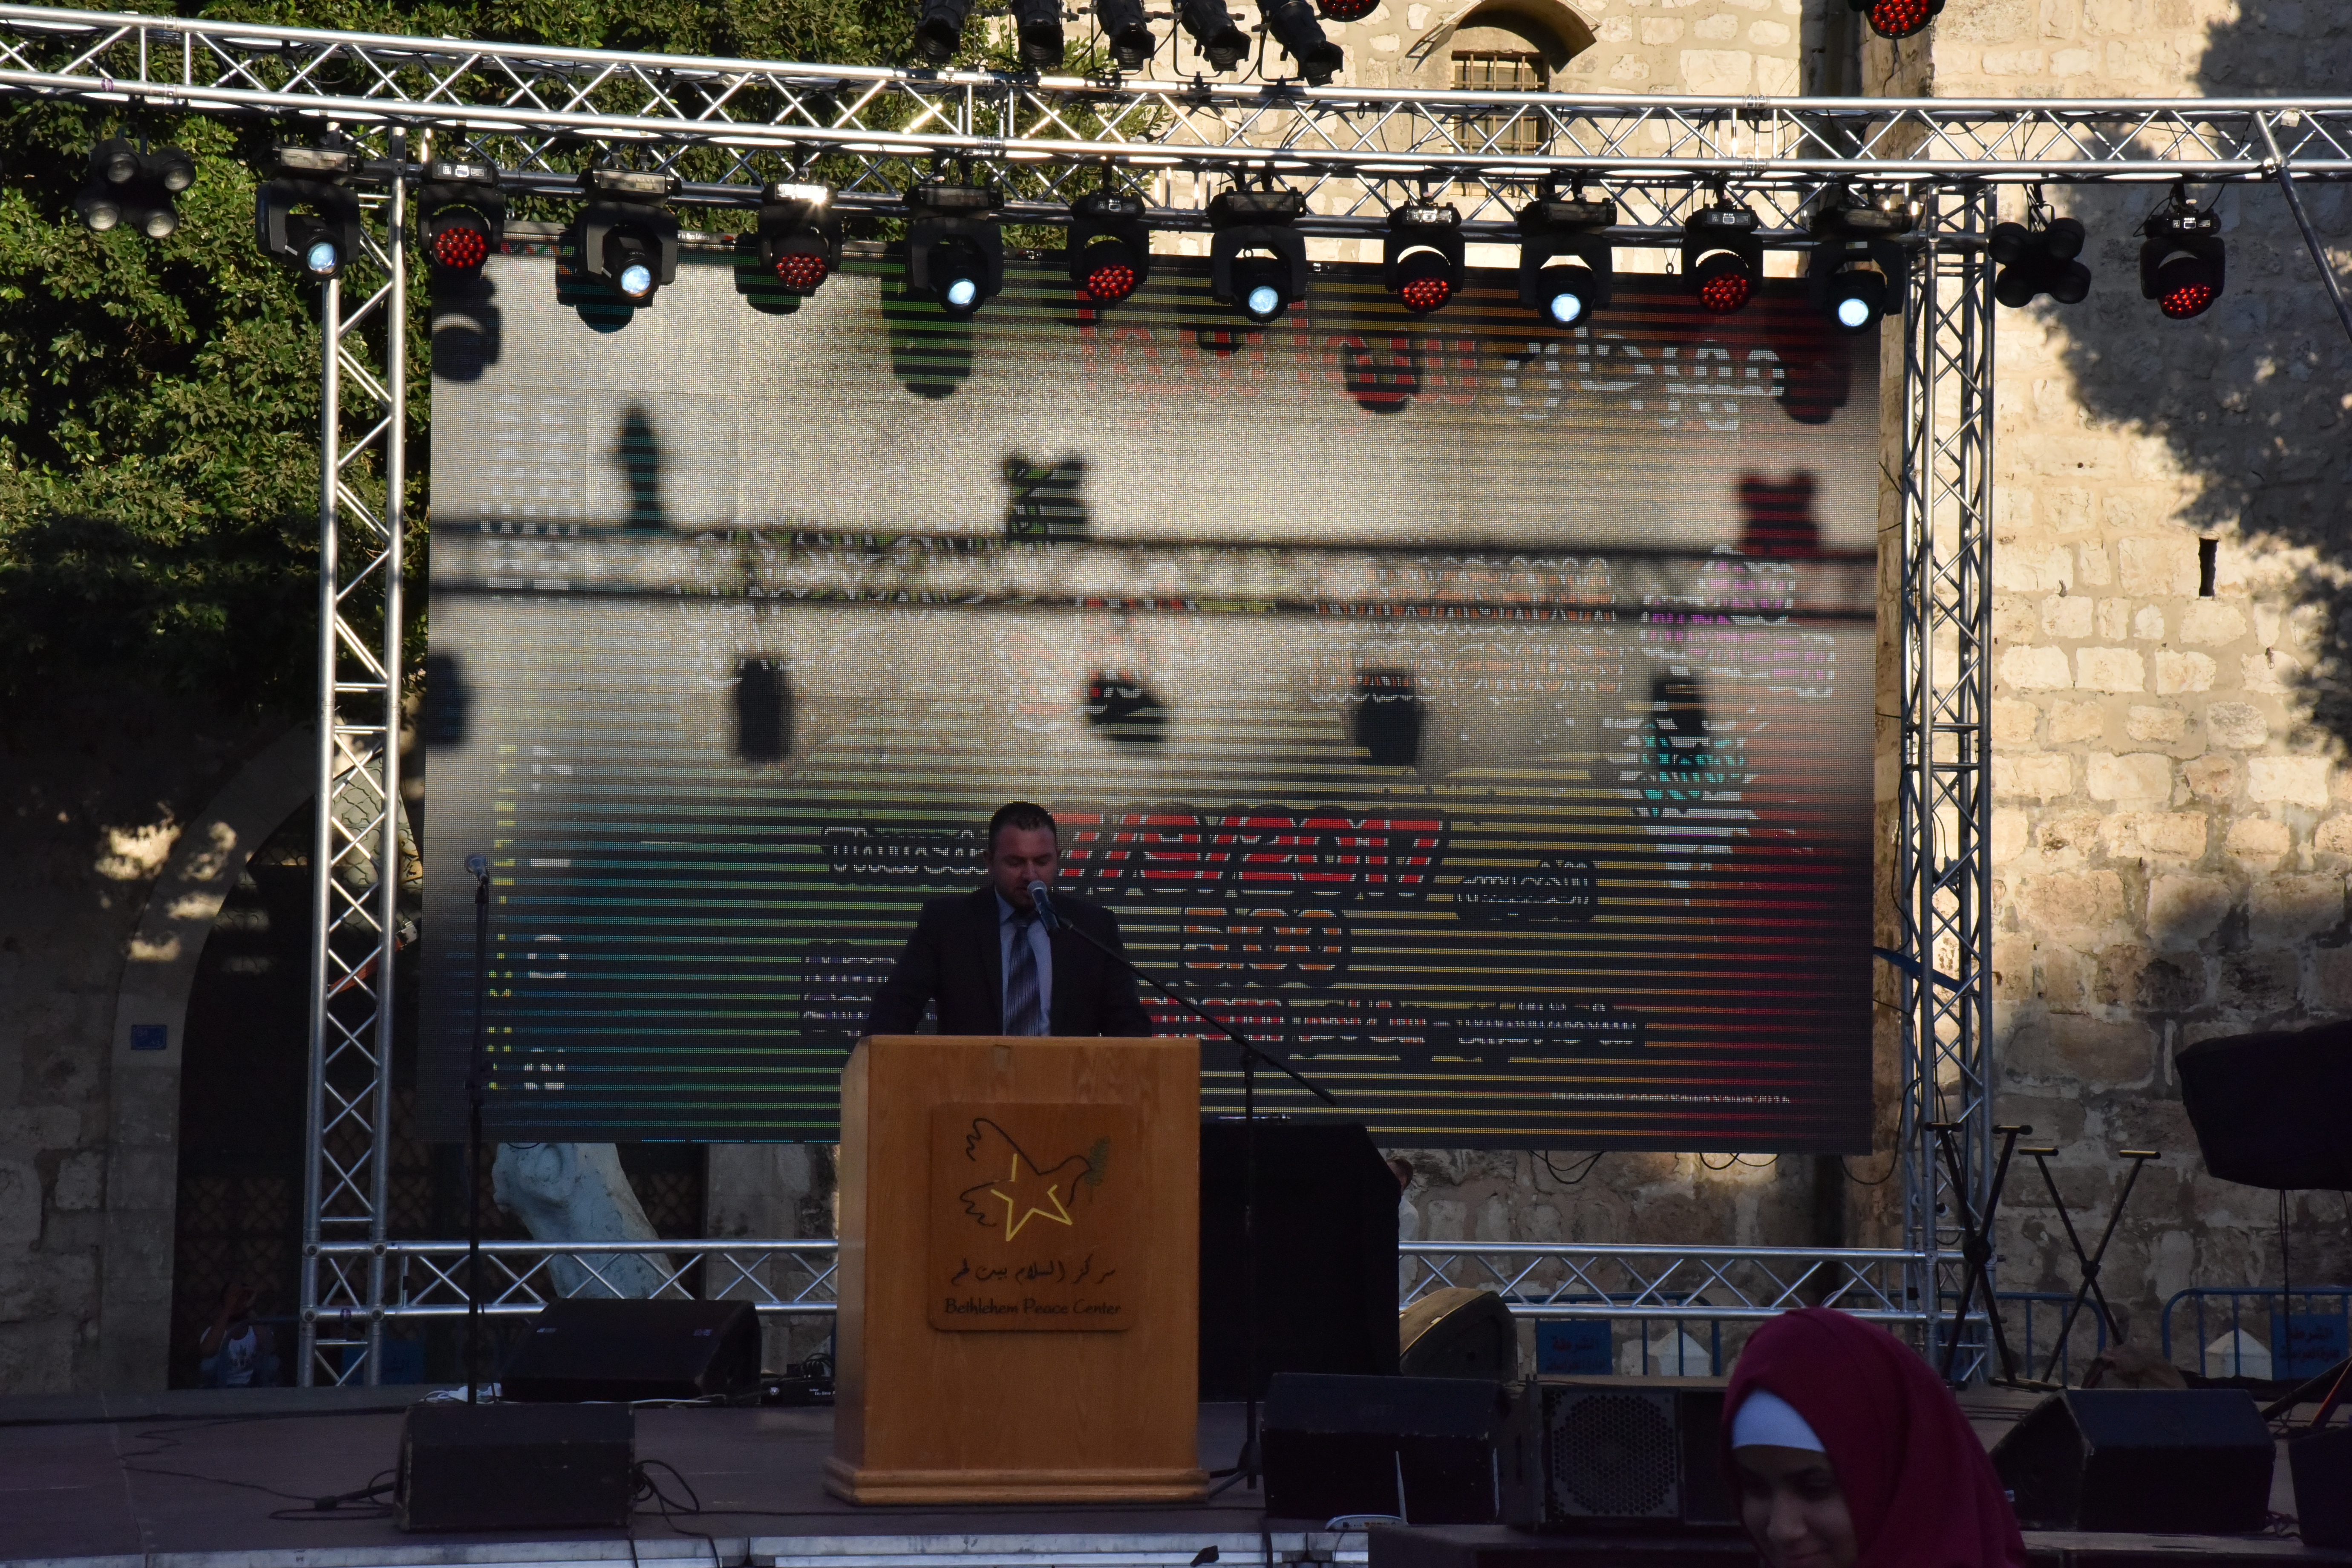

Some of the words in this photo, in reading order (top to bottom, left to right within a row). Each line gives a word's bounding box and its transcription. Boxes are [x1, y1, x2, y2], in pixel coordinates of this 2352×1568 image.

[944, 1297, 1018, 1315] Bethlehem
[1023, 1297, 1068, 1314] Peace
[1073, 1298, 1121, 1315] Center
